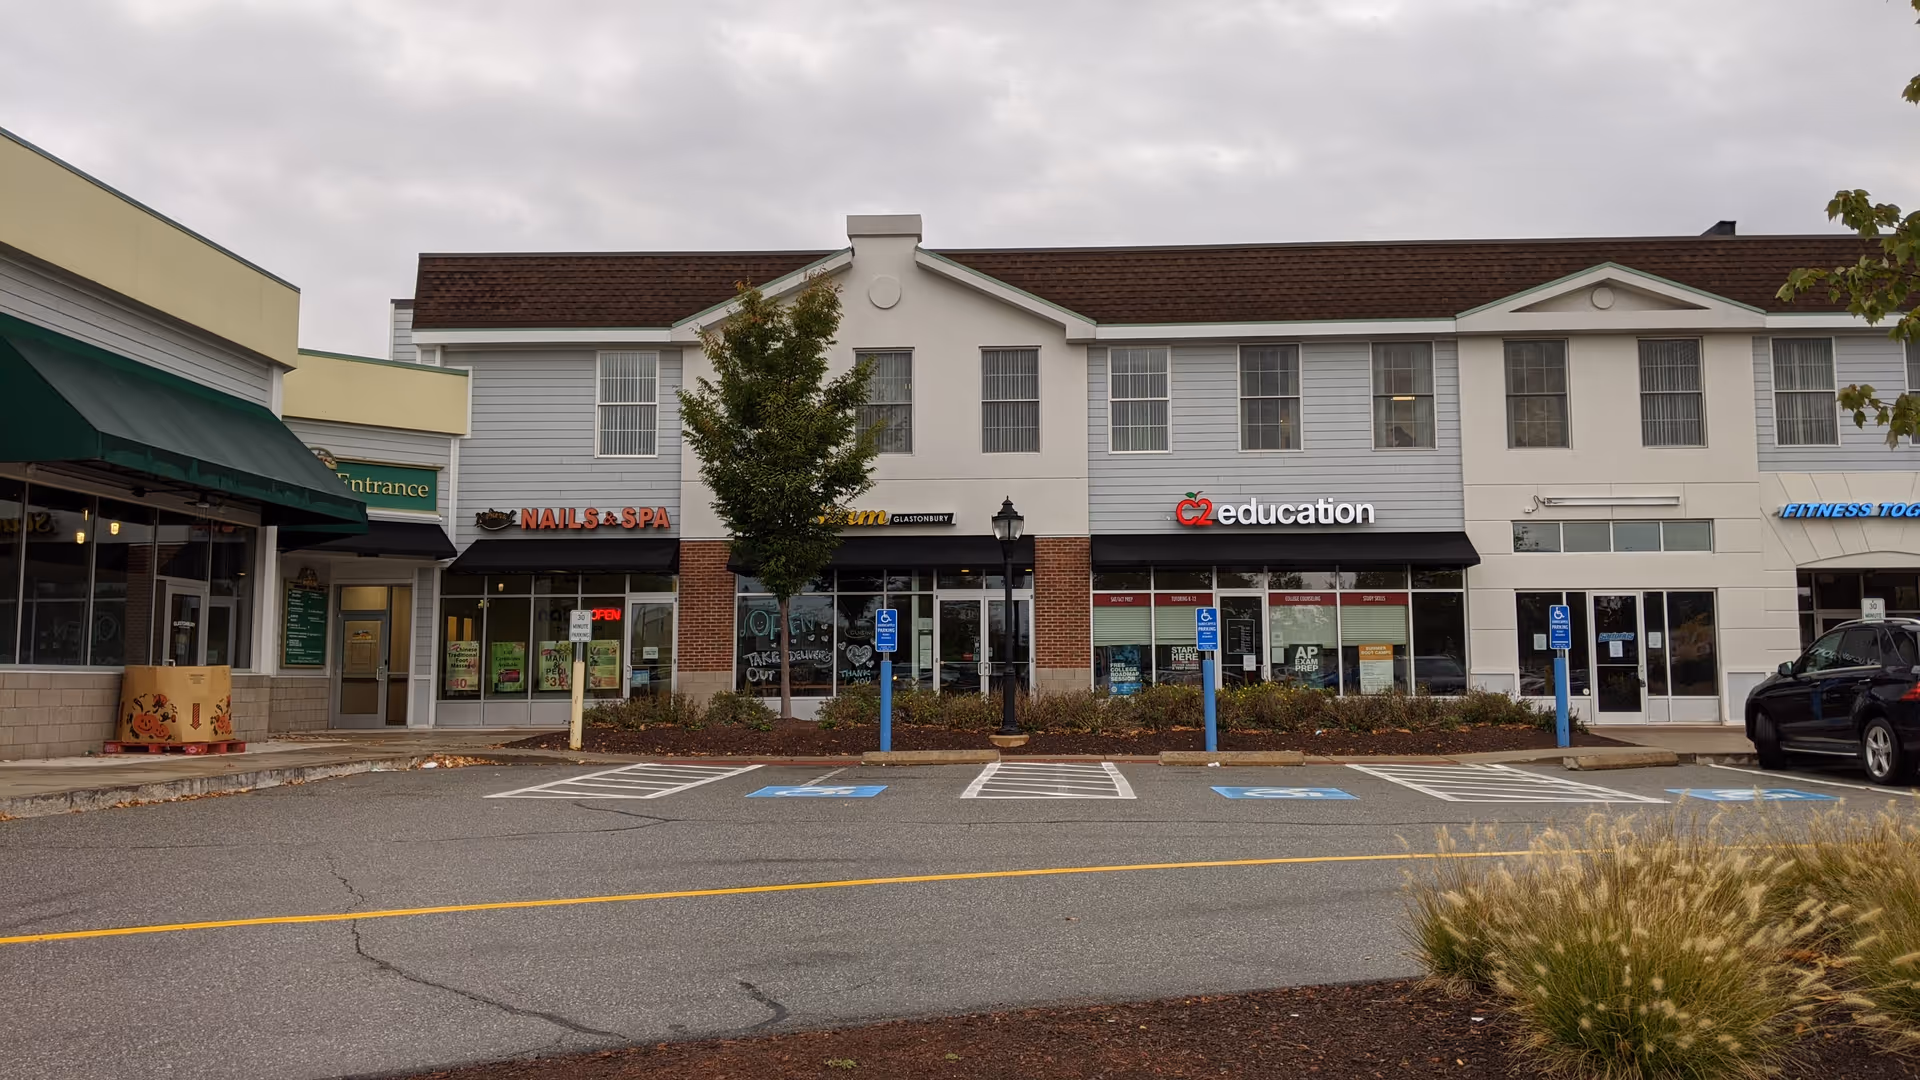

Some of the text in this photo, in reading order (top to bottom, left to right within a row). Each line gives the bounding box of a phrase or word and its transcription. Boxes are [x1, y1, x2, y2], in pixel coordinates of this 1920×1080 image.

[1176, 497, 1375, 526] C2 education
[1782, 503, 1874, 518] FITNESS
[521, 507, 599, 529] NAILS
[603, 510, 617, 526] &
[621, 507, 670, 529] SPA
[893, 515, 949, 523] GLASTONBURY
[1869, 602, 1878, 610] 30
[592, 608, 621, 621] OPEN
[545, 654, 567, 662] MANI
[1171, 653, 1199, 661] HERE
[1295, 646, 1318, 659] AP
[743, 651, 781, 667] TAKE
[840, 669, 871, 678] THANK
[853, 677, 872, 685] YOU
